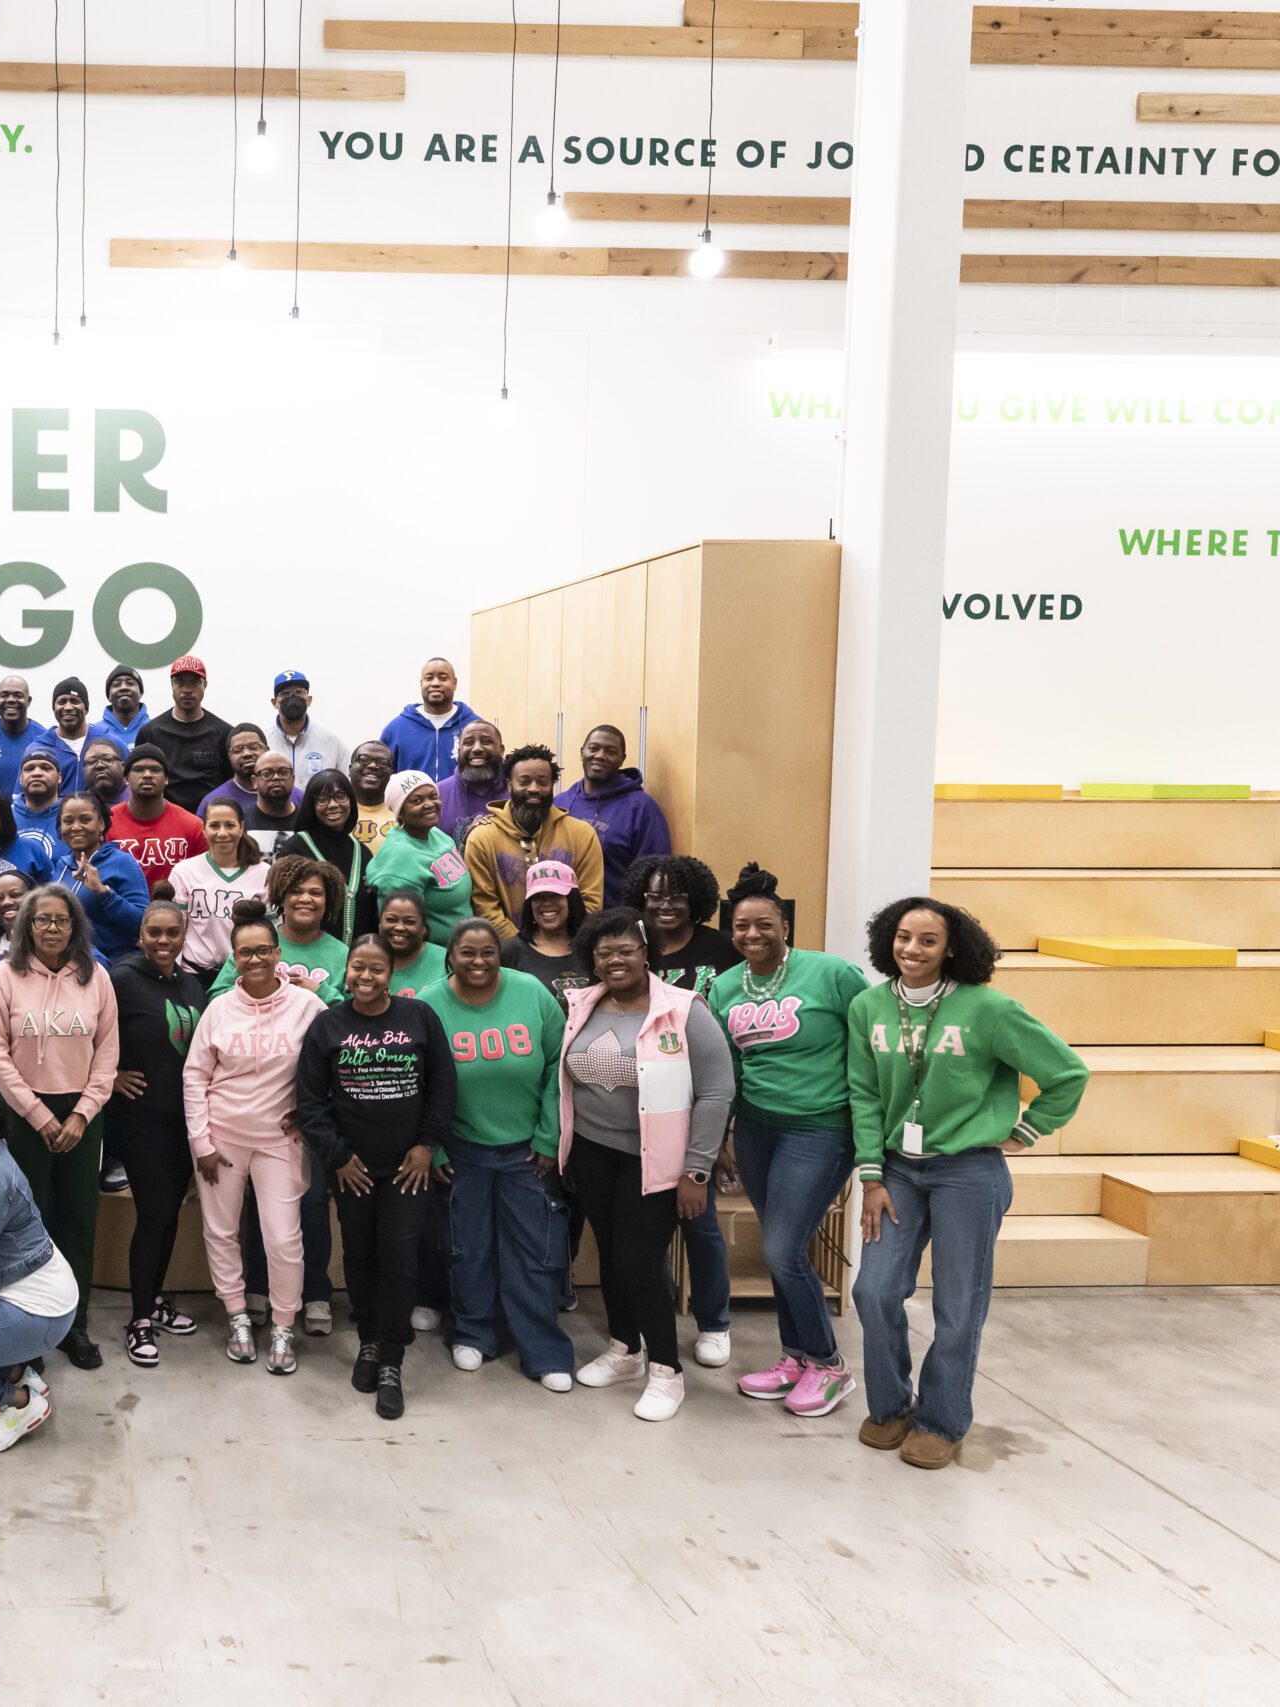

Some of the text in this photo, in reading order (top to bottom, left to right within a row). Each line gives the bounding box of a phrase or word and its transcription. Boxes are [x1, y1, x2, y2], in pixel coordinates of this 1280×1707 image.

[319, 131, 403, 161] YOU
[423, 133, 498, 163] ARE
[517, 134, 546, 164] A
[562, 136, 717, 168] SOURCE
[735, 140, 787, 169] OF
[806, 141, 854, 170] JO
[1003, 144, 1217, 176] CERTAINTY
[1232, 148, 1280, 177] FO
[768, 390, 845, 419] WH
[999, 394, 1087, 423] GIVE
[1104, 396, 1193, 425] WILL
[1118, 528, 1280, 557] WHERE T
[943, 592, 1083, 621] VOLVED
[728, 996, 803, 1036] 1908
[340, 1030, 412, 1051] Alpha Beta
[338, 1047, 418, 1072] Delta Omega
